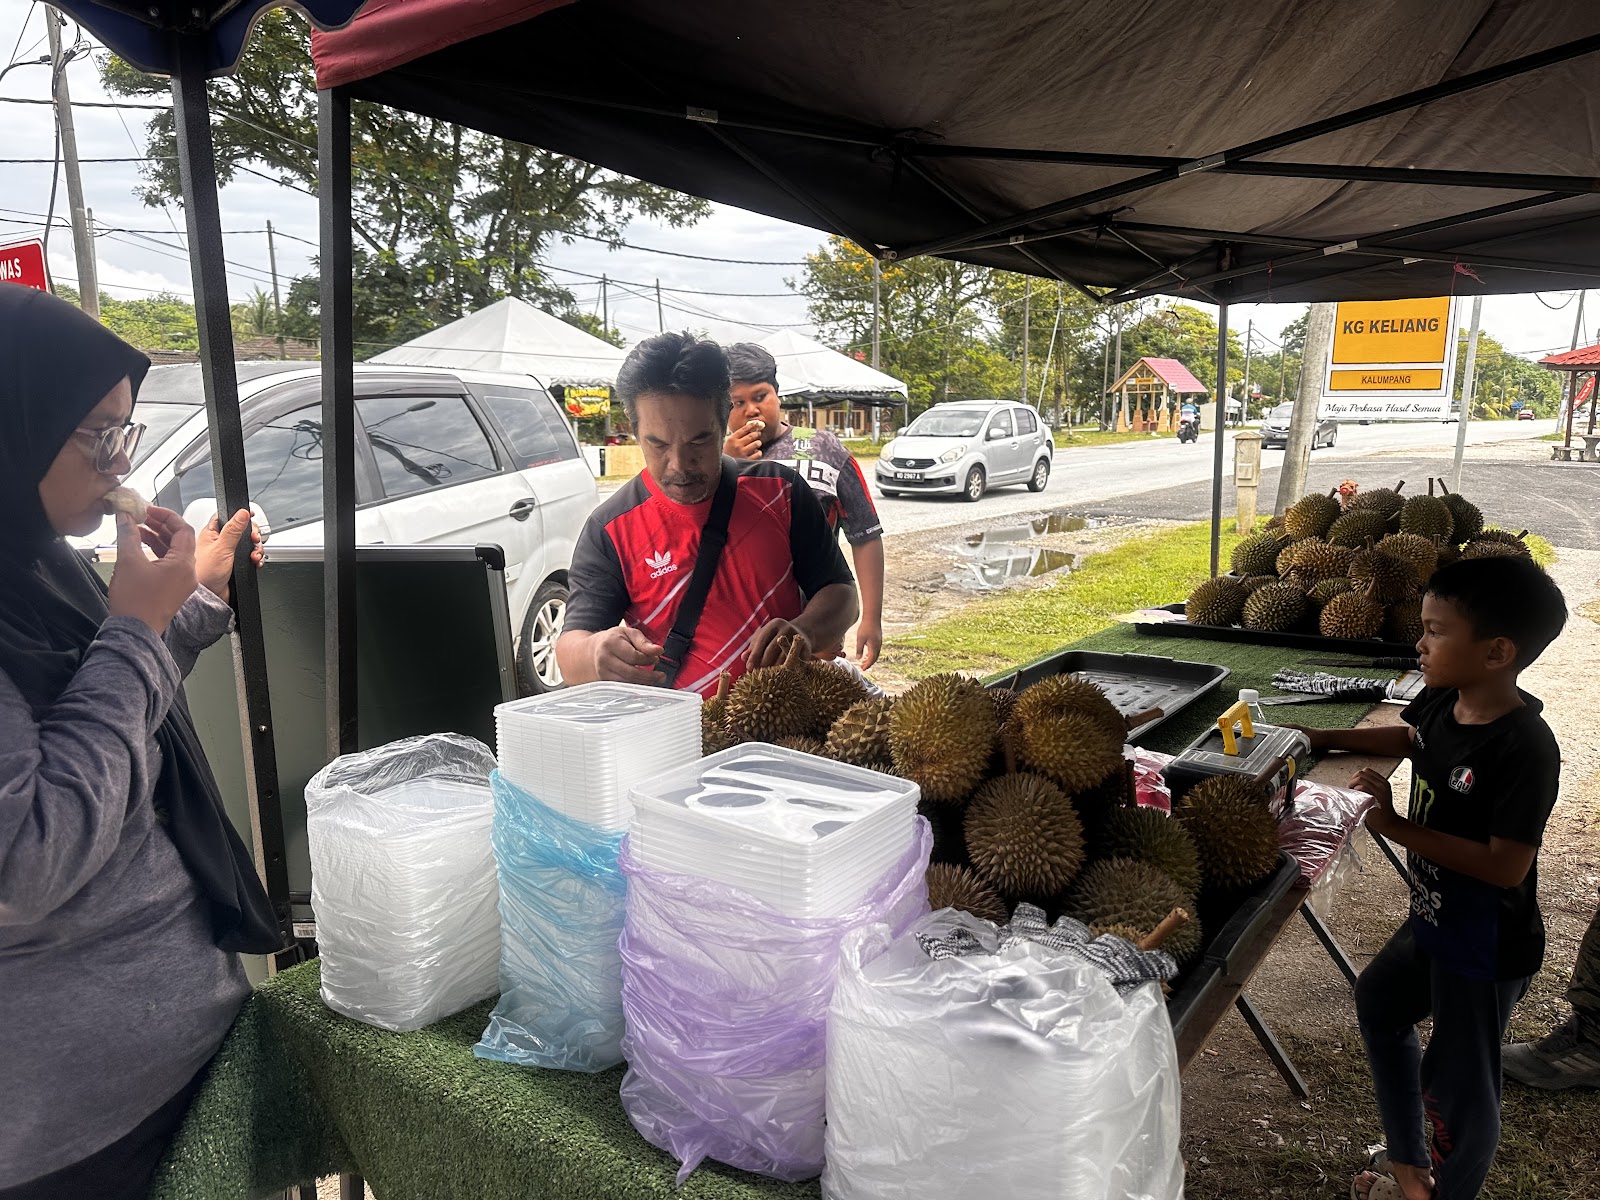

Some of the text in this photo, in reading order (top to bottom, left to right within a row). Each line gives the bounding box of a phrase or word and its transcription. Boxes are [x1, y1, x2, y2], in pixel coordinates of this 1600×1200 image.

[1343, 318, 1439, 334] KG KELIANG
[1361, 375, 1411, 384] KALUMPANG
[1324, 403, 1442, 414] Maju Perkasa Hasil Semua
[650, 564, 678, 579] adidas
